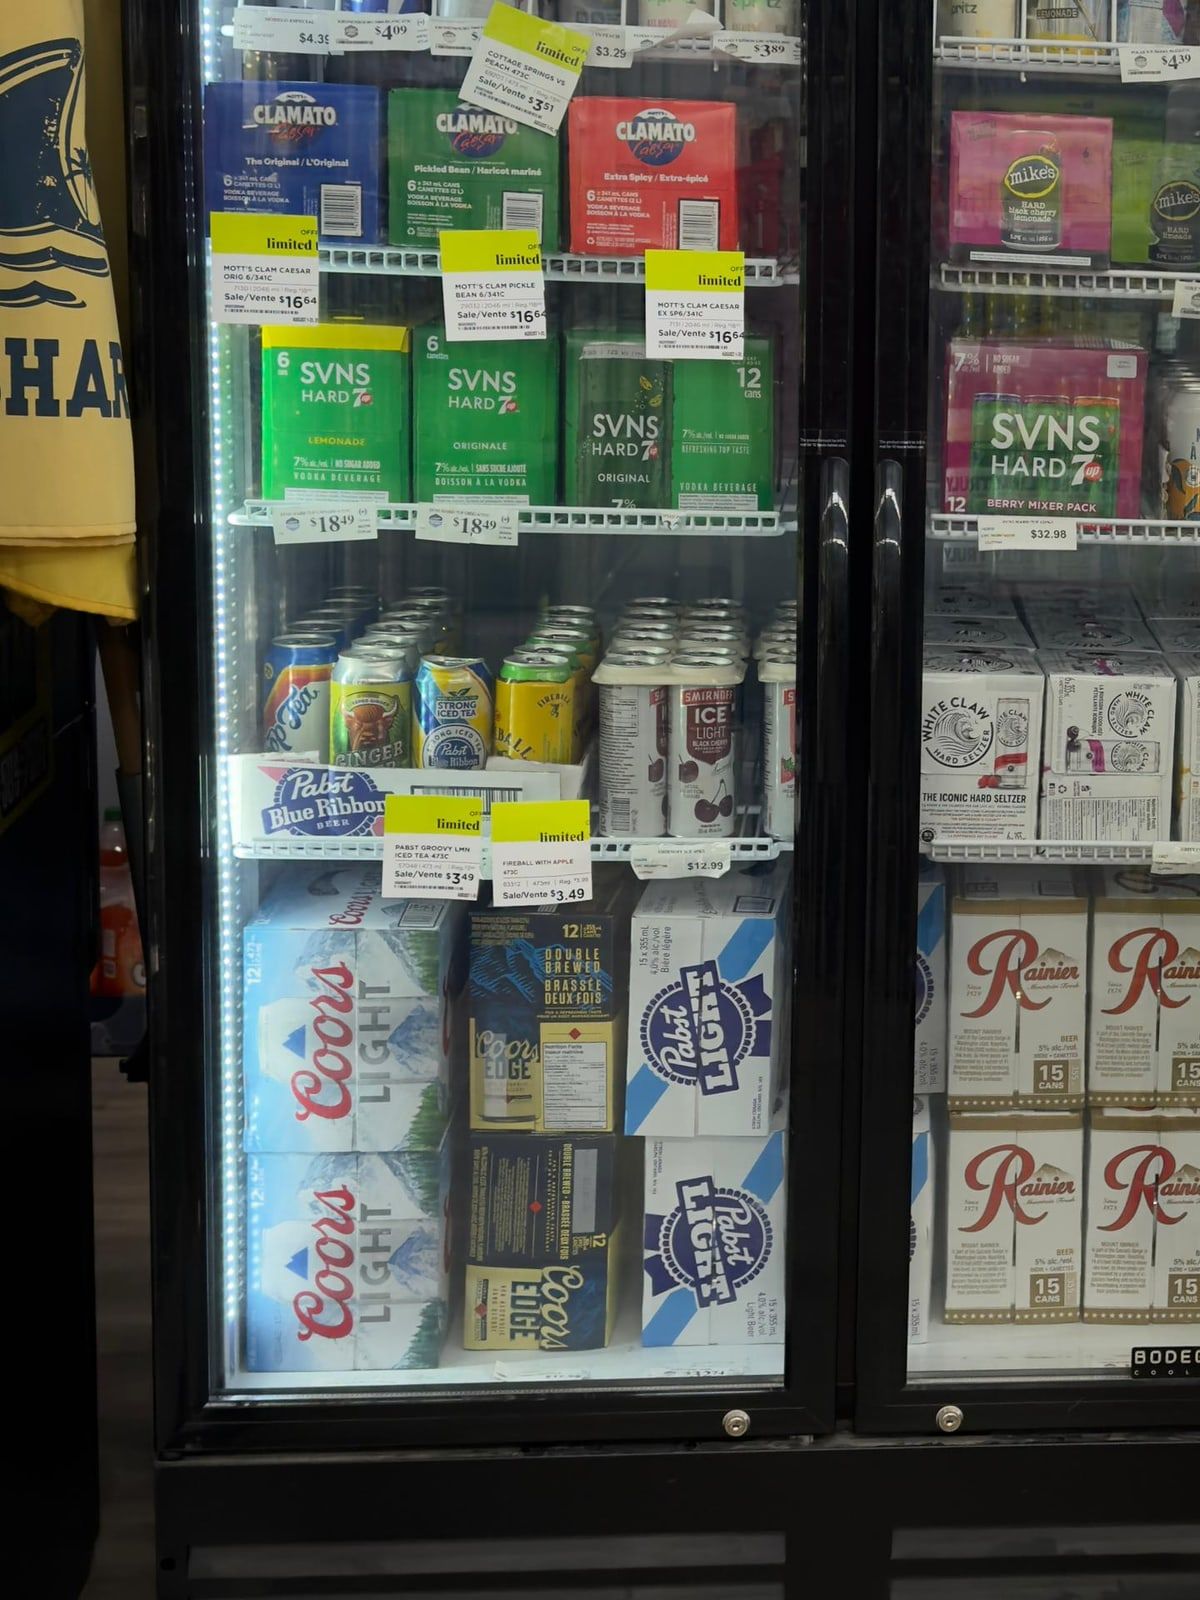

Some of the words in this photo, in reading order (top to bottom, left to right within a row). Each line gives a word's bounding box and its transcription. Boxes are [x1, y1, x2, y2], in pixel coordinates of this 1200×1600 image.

[1037, 8, 1079, 18] LEMONADE
[536, 41, 580, 66] limited
[596, 46, 627, 58] $3.29
[485, 58, 511, 71] PEACH
[488, 51, 522, 69] COTTAGE
[523, 64, 555, 82] SPRINGS
[557, 78, 566, 86] VS
[253, 105, 336, 126] CLAMATO
[436, 113, 518, 134] CLAMATO
[616, 122, 695, 142] CLAMATO
[245, 158, 262, 166] The
[264, 158, 299, 167] Original
[306, 159, 348, 167] L'Original
[414, 165, 447, 174] Pickled
[448, 166, 470, 174] Bean
[1009, 166, 1056, 186] mike's
[604, 173, 628, 181] Extra
[629, 173, 653, 182] Spicy
[408, 180, 416, 191] 6
[267, 238, 312, 251] limited
[495, 254, 540, 265] limited
[455, 282, 483, 290] MOTT'S
[485, 282, 507, 290] CLAM
[698, 274, 741, 287] limited
[224, 293, 276, 302] Sale/Vente
[457, 310, 507, 320] Sale/Vente
[658, 328, 707, 339] Sale/Vente
[277, 352, 290, 367] 6
[0, 338, 130, 419] HAR
[300, 362, 370, 386] SVNS
[448, 368, 516, 393] SVNS
[737, 367, 761, 388] 12
[301, 389, 349, 404] HARD
[448, 396, 495, 410] HARD
[593, 414, 659, 439] SVNS
[991, 413, 1100, 452] SVNS
[308, 436, 365, 446] LEMONADE
[453, 442, 508, 450] ORIGINALE
[592, 442, 638, 456] HARD
[991, 455, 1066, 478] HARD
[597, 473, 650, 483] ORIGINAL
[987, 499, 1024, 510] BERRY
[1028, 500, 1064, 511] MIXER
[1067, 503, 1096, 513] PACK
[1031, 530, 1067, 539] $32.98
[685, 690, 734, 703] SMIRNOFF
[438, 700, 477, 710] STRONG
[694, 706, 726, 723] ICE
[922, 700, 949, 742] WHITE
[950, 697, 990, 720] CLAW
[696, 726, 726, 739] LIGHT
[287, 770, 354, 800] Pabst
[922, 793, 937, 803] THE
[939, 793, 968, 803] ICONIC
[970, 793, 992, 803] HARD
[994, 794, 1027, 803] SELTZER
[268, 804, 315, 830] Blue
[317, 798, 385, 819] Ribbon
[317, 818, 350, 830] BEER
[437, 819, 479, 831] limited
[540, 832, 584, 842] limited
[687, 861, 724, 871] $12.99
[395, 870, 442, 879] Sale/Vente
[503, 891, 547, 900] Sale/Vente
[550, 888, 585, 901] $3.49
[545, 948, 600, 960] DOUBLE
[545, 961, 600, 974] BREWED
[545, 977, 601, 992] BRASSÉE
[545, 993, 572, 1005] DEUX
[577, 993, 601, 1005] FOIS
[291, 961, 354, 1121] Coors
[359, 980, 391, 1103] LIGHT
[659, 1004, 697, 1071] Pabst
[1039, 1065, 1064, 1081] 15
[1177, 1063, 1200, 1079] 15
[1038, 1081, 1064, 1089] CANS
[957, 1144, 1076, 1233] Rainier
[293, 1184, 356, 1341] Coors
[359, 1202, 392, 1323] LIGHT
[1035, 1278, 1060, 1294] 15
[1173, 1278, 1198, 1294] 15
[1034, 1295, 1060, 1303] CANS
[1173, 1295, 1198, 1304] CANS
